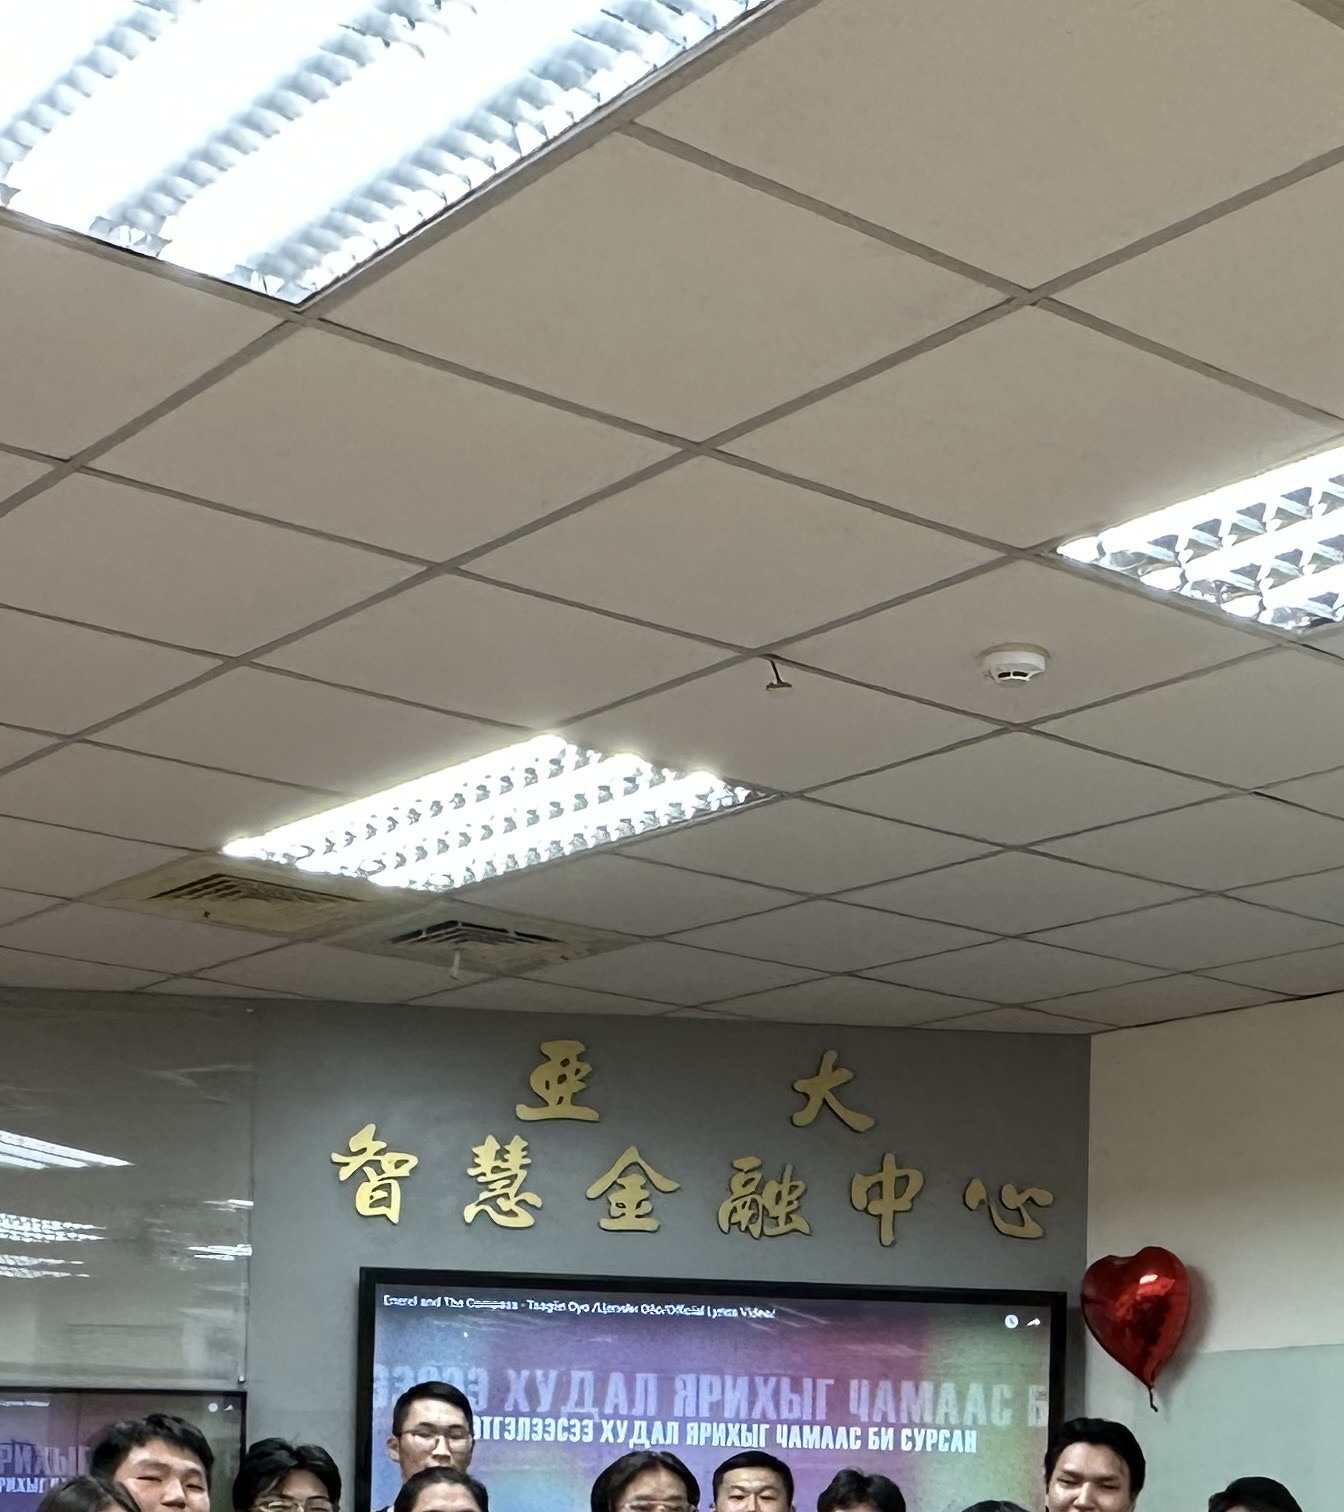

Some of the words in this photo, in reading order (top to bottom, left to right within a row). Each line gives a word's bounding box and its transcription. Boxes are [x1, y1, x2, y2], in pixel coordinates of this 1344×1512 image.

[330, 1122, 1055, 1247] 智慧金融中心
[504, 1368, 657, 1423] ХУДАЛ
[674, 1373, 834, 1421] ЯРИХЫГ
[849, 1379, 1012, 1427] ЧАМААС
[600, 1419, 679, 1449] ХУДАЛ
[686, 1422, 770, 1448] ЯРИХЫГ
[776, 1424, 861, 1450] ЧАМААС
[868, 1426, 894, 1452] БИ
[900, 1428, 978, 1454] СУРСАН
